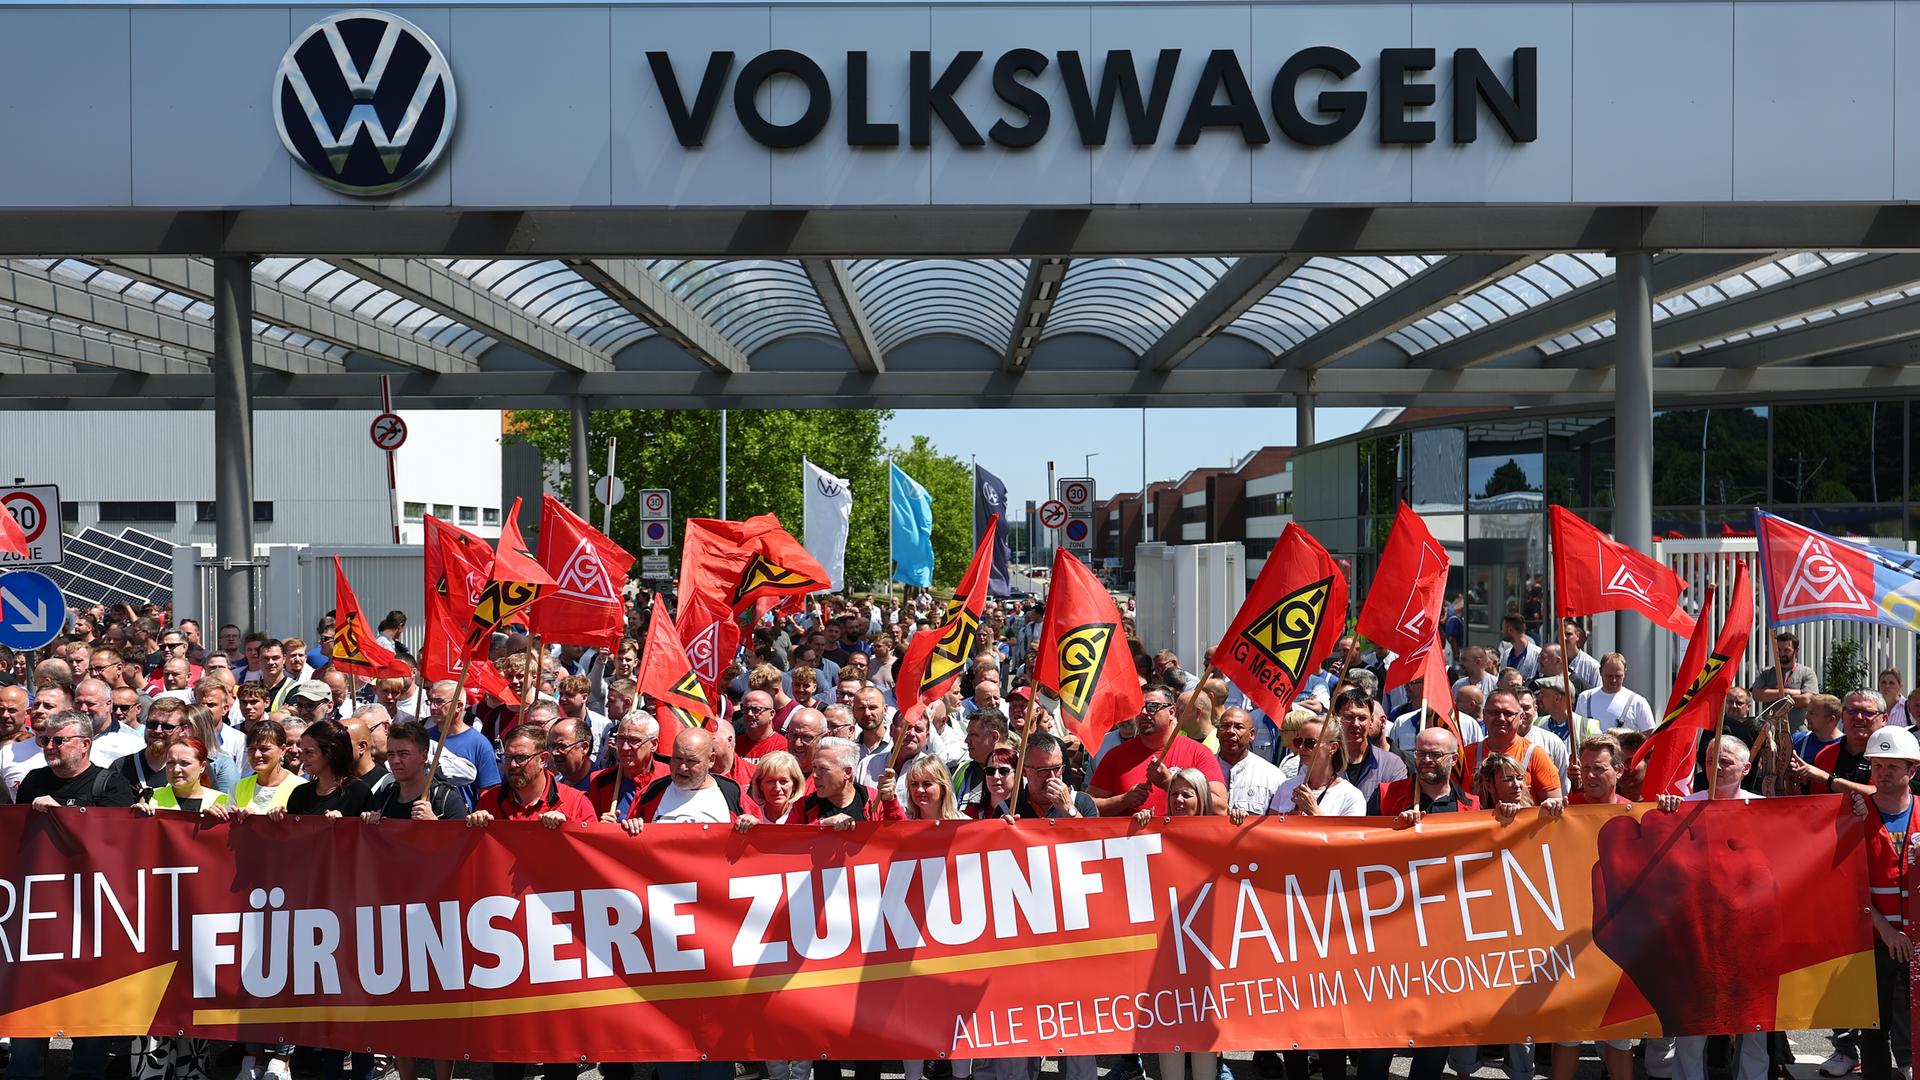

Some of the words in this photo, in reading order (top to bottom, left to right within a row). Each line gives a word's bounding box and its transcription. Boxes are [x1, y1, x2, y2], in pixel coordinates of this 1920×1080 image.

[645, 46, 1538, 149] VOLKSWAGEN
[1070, 489, 1083, 499] 30
[1229, 638, 1248, 664] IG
[1248, 654, 1294, 708] Metall
[192, 886, 342, 999] FÜR
[355, 882, 706, 996] UNSERE
[728, 833, 1162, 967] ZUKUNFT
[1169, 843, 1565, 975] KÄMPFEN
[952, 1007, 1028, 1051] ALLE
[1037, 978, 1300, 1039] BELEGSCHAFTEN
[1308, 970, 1348, 1008] IM
[1354, 944, 1576, 1000] VW-KONZERN
